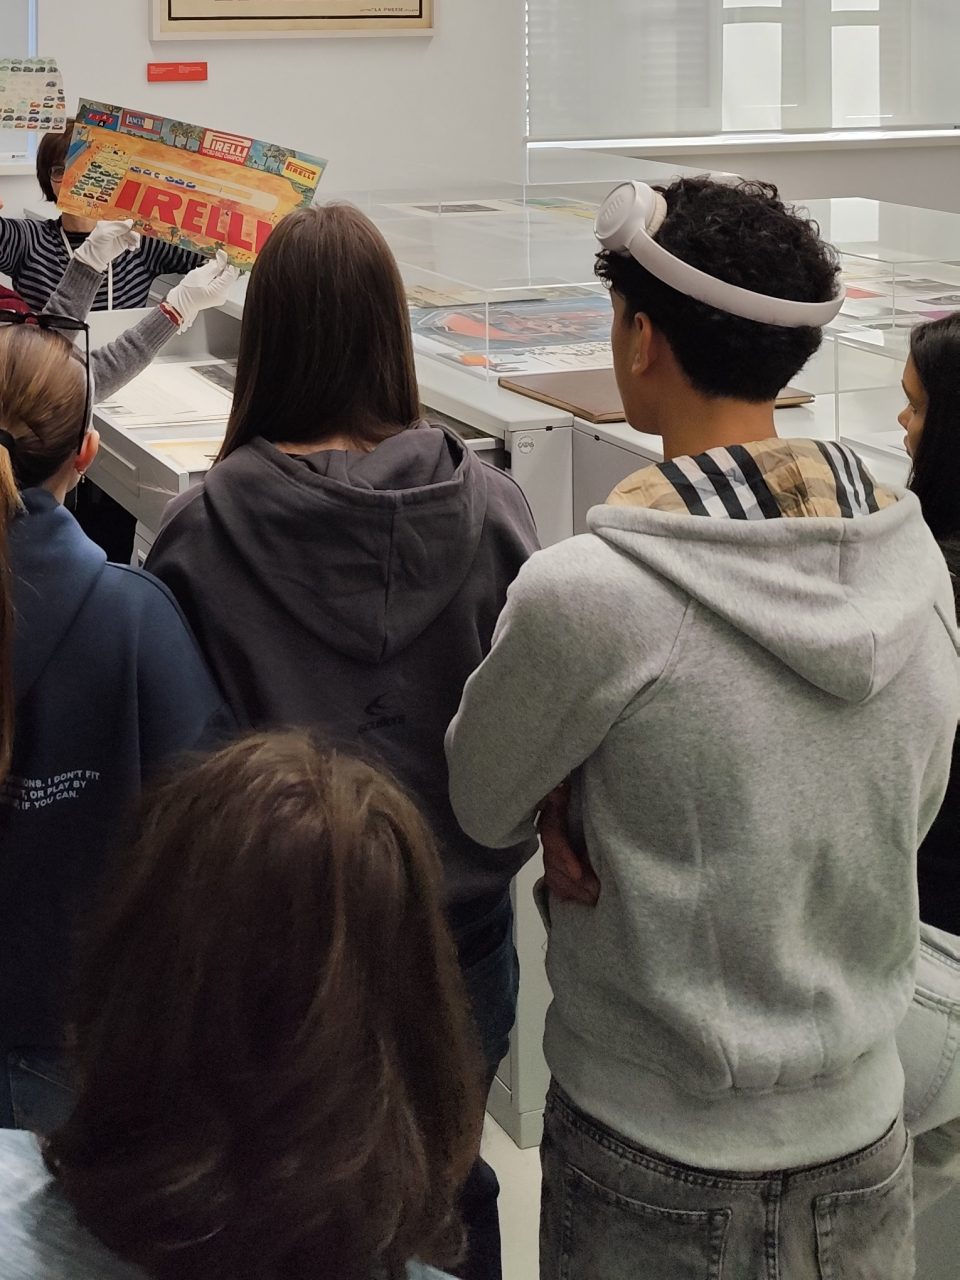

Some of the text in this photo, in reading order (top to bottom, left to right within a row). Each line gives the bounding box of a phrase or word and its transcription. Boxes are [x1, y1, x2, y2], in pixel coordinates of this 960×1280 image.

[204, 130, 252, 158] PIRELLI
[285, 161, 317, 181] PIRELLI
[48, 778, 52, 786] I
[54, 770, 83, 783] DON'T
[85, 771, 100, 780] FIT
[30, 790, 44, 799] OR
[47, 783, 70, 795] PLAY
[73, 780, 87, 788] BY
[21, 801, 31, 810] IF
[34, 796, 54, 809] YOU
[56, 790, 79, 800] CAN.
